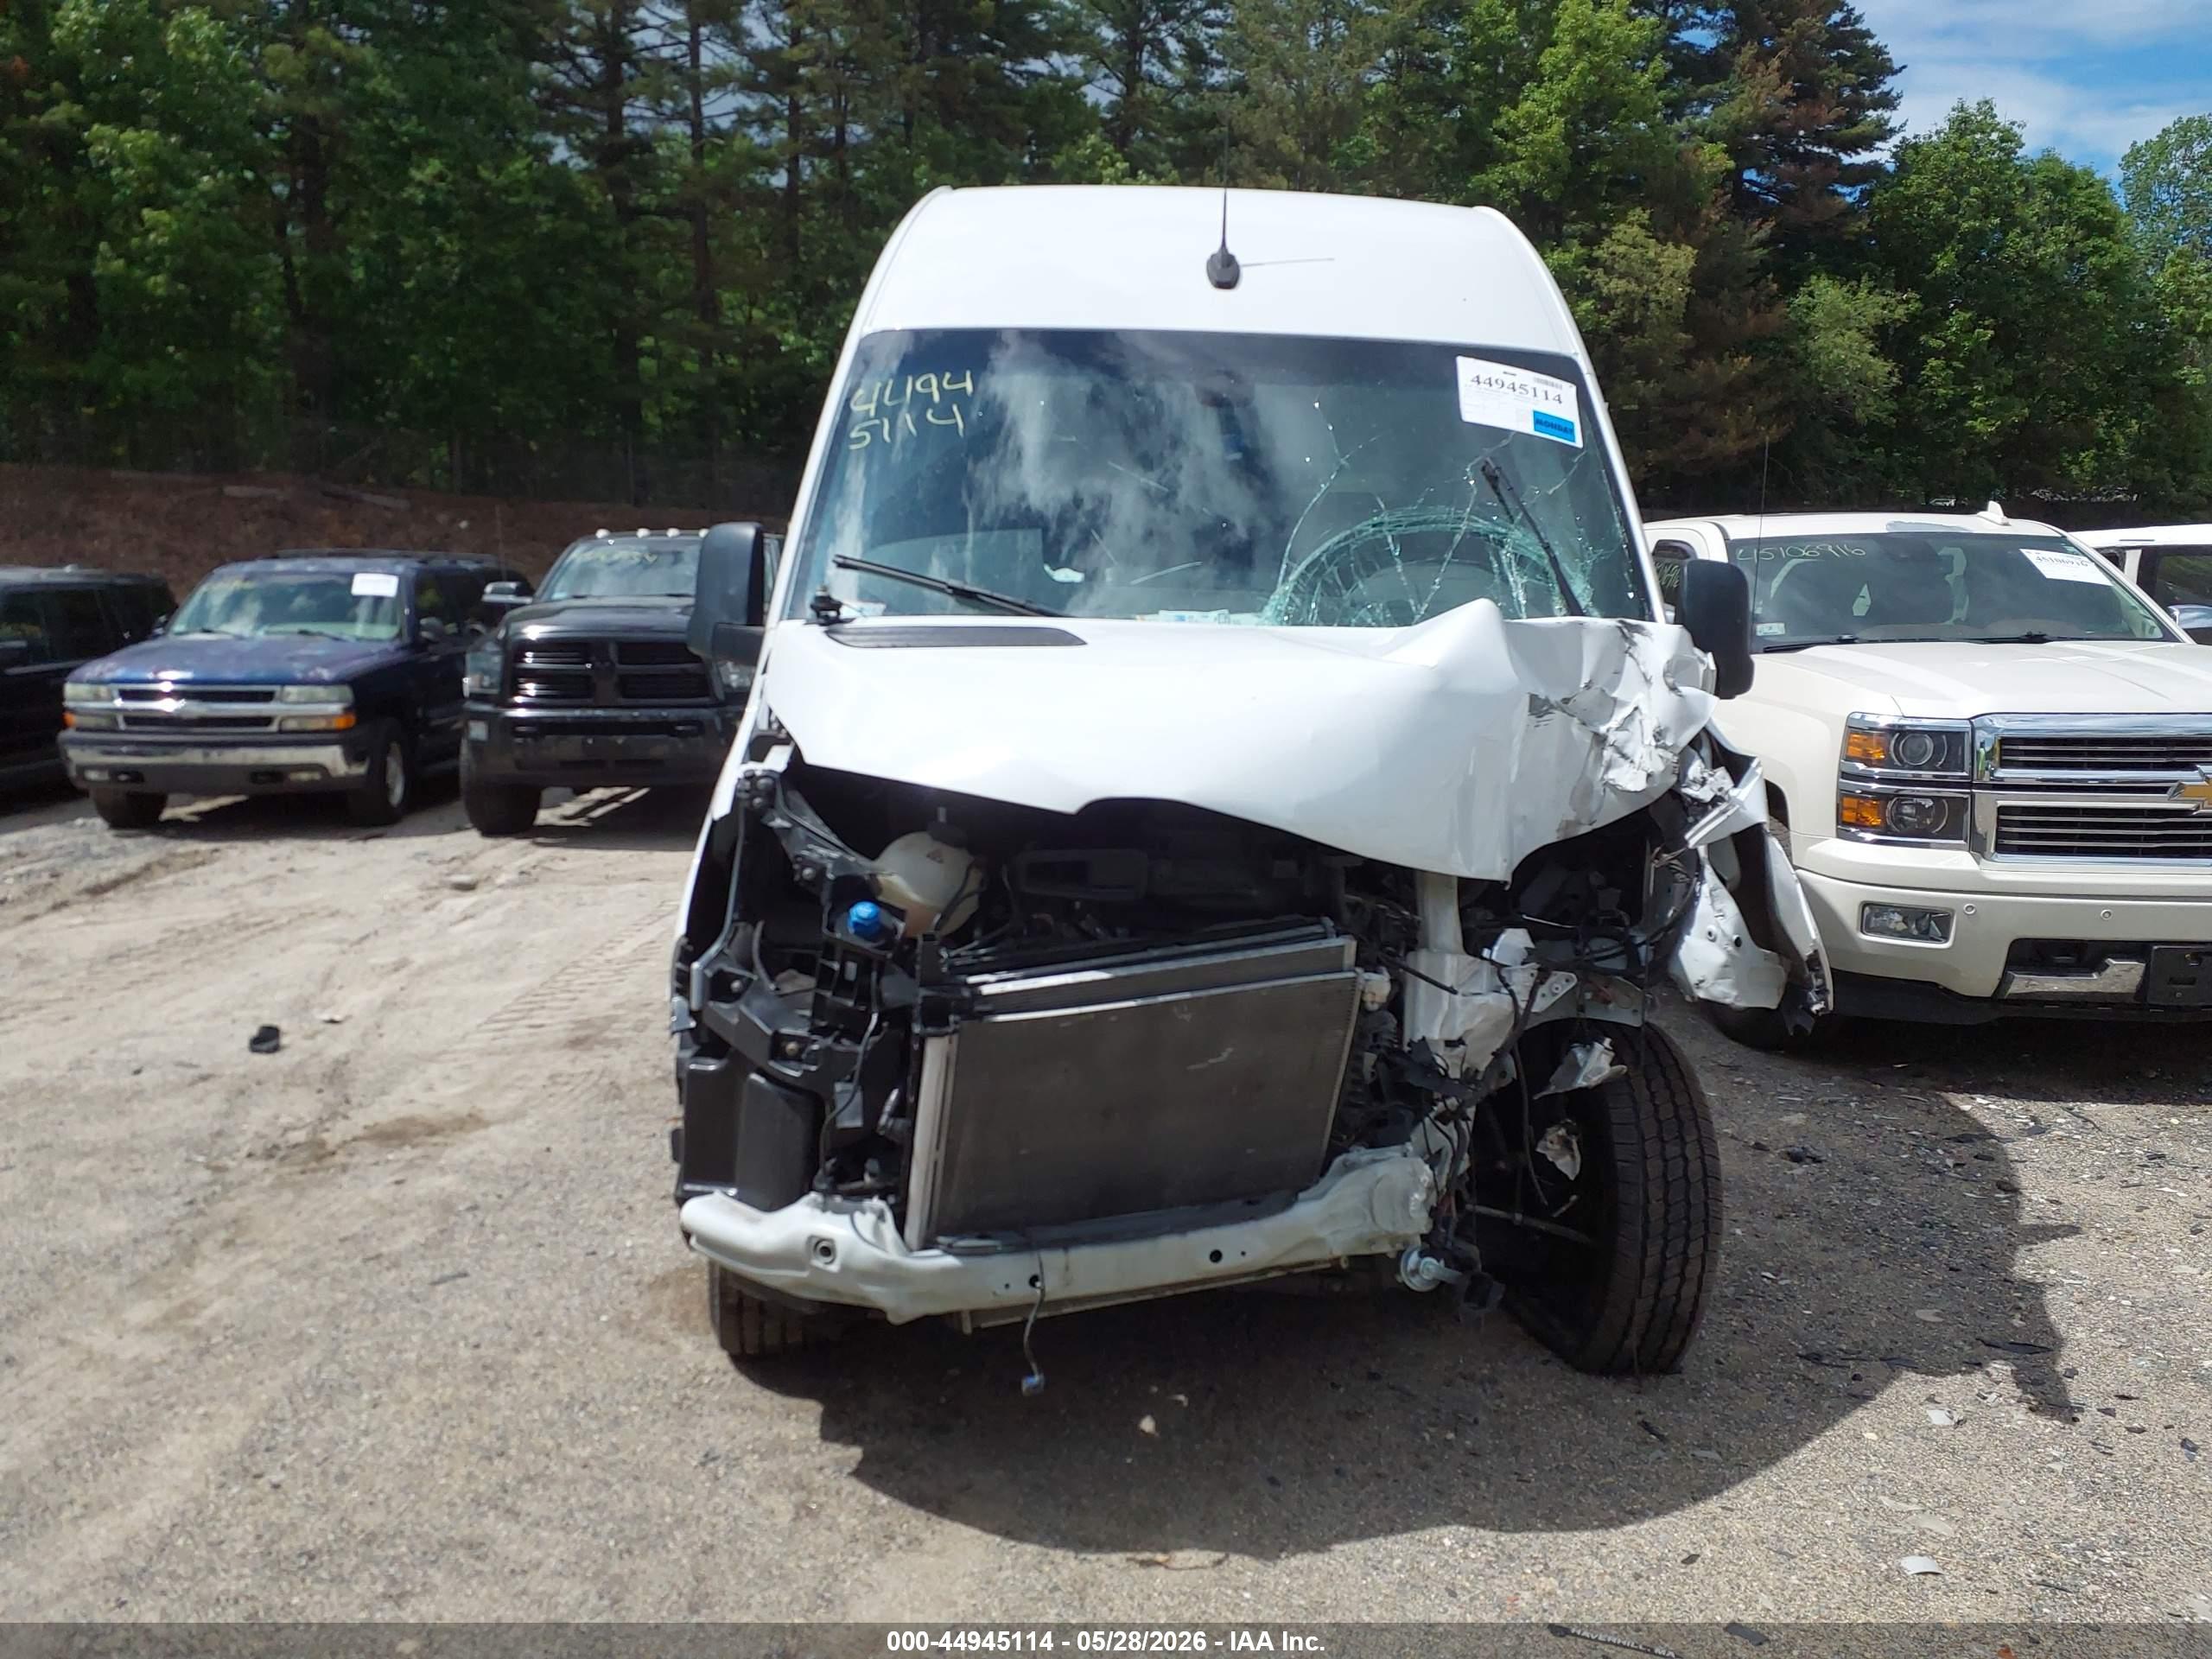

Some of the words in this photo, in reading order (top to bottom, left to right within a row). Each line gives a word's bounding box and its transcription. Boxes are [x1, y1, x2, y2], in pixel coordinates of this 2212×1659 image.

[850, 370, 973, 416] 4494
[1471, 374, 1562, 404] 44945114
[849, 404, 963, 449] 5114
[1735, 543, 1866, 563] 45106916
